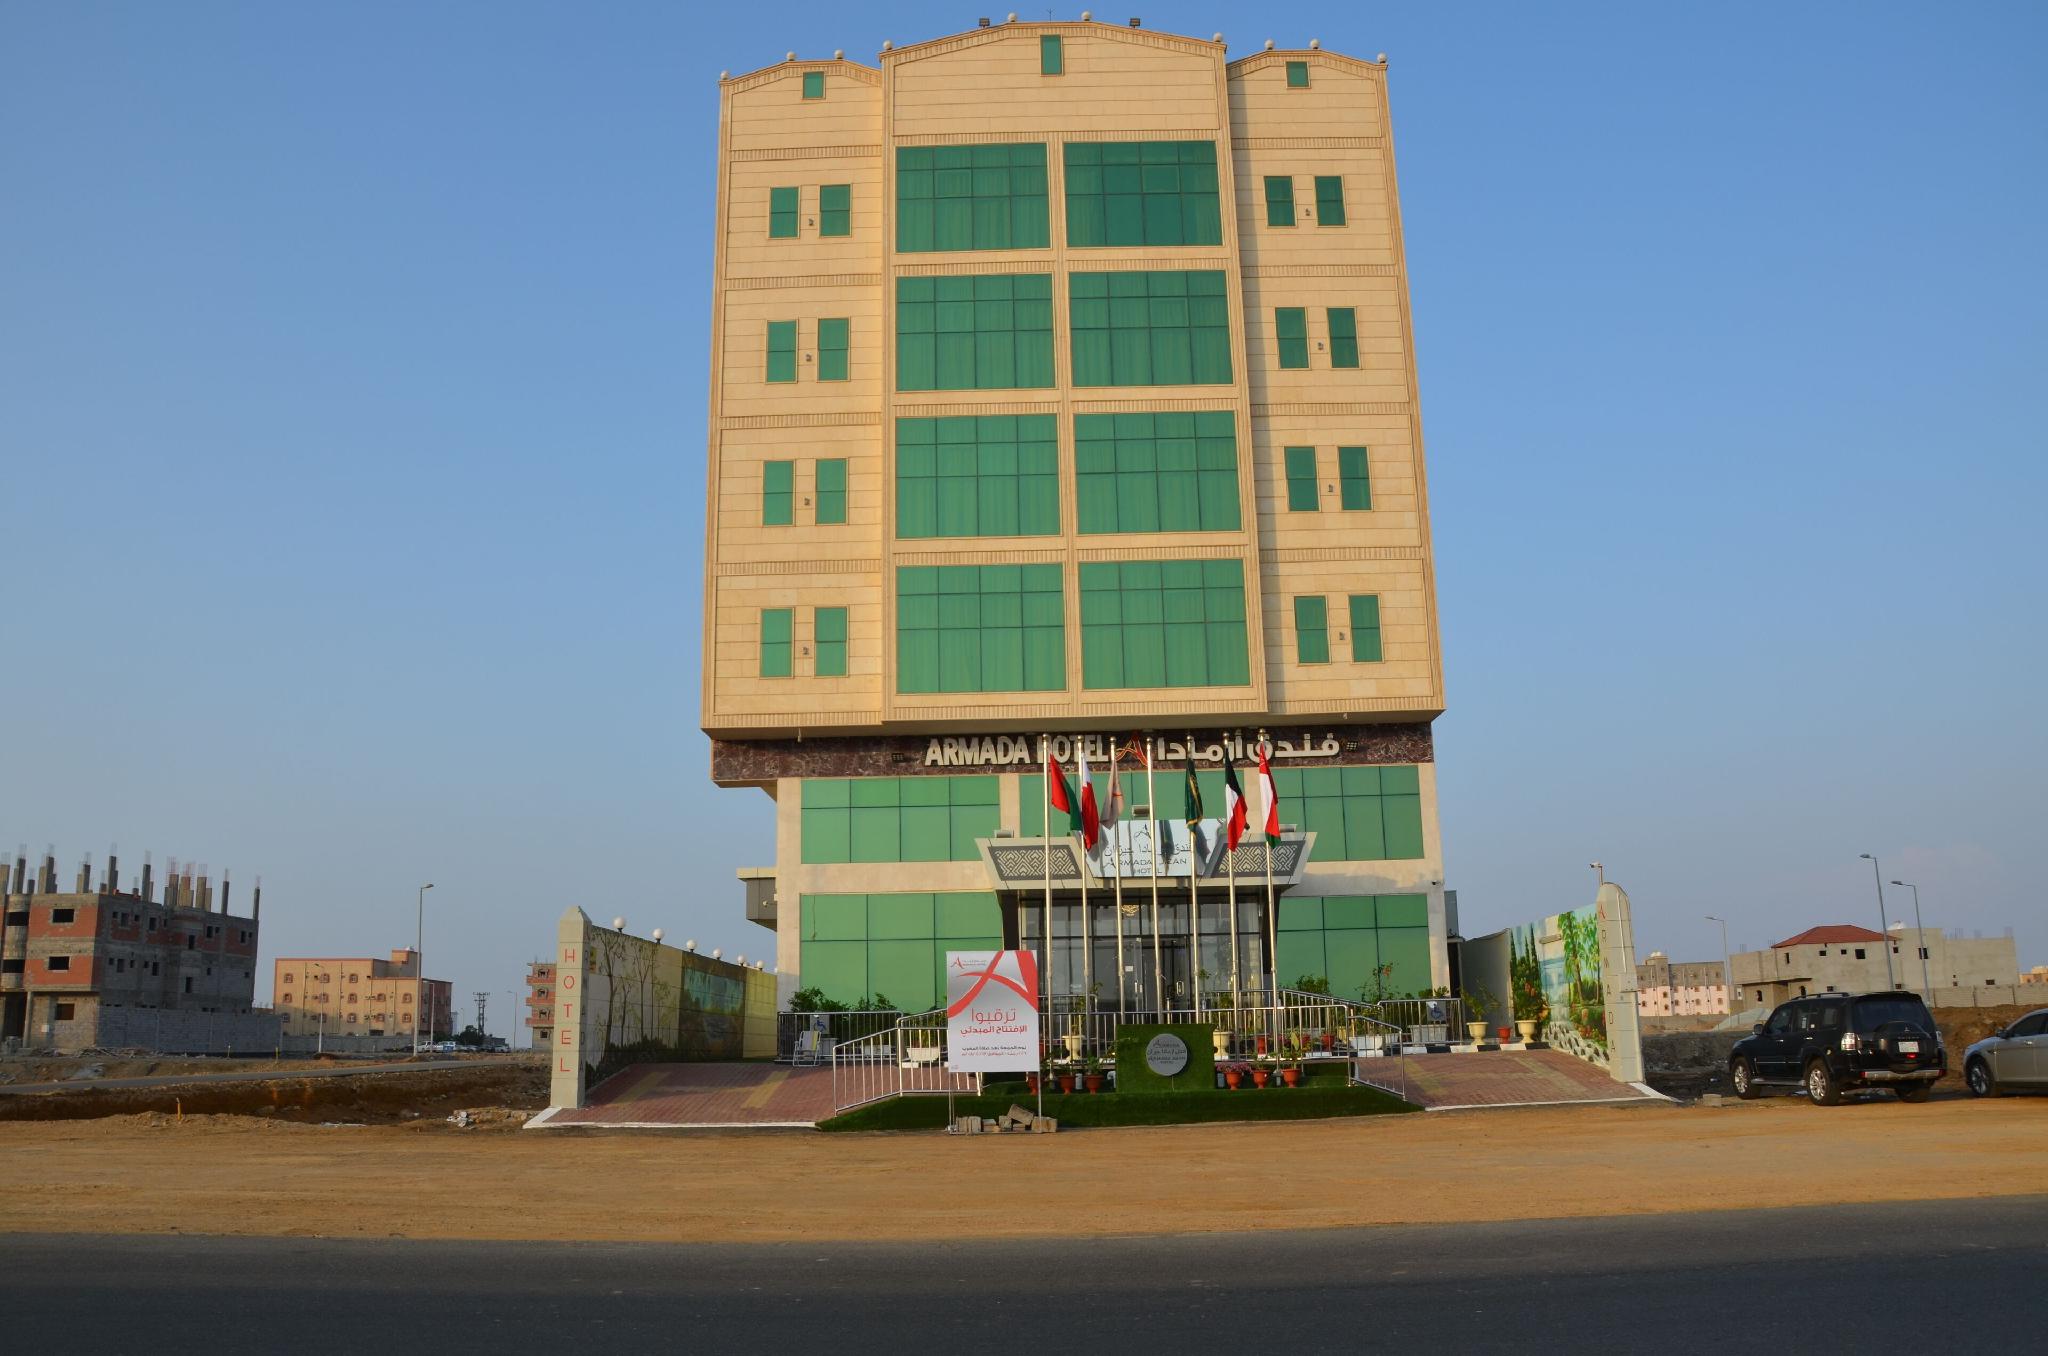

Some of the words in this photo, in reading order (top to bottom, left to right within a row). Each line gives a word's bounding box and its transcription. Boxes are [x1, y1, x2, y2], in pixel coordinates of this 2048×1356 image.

[925, 736, 1031, 766] ARMADA
[1036, 734, 1109, 763] HOTEL
[1246, 732, 1340, 763] فندق
[560, 948, 575, 1072] HOTEL
[971, 1007, 1016, 1024] ترقبوا
